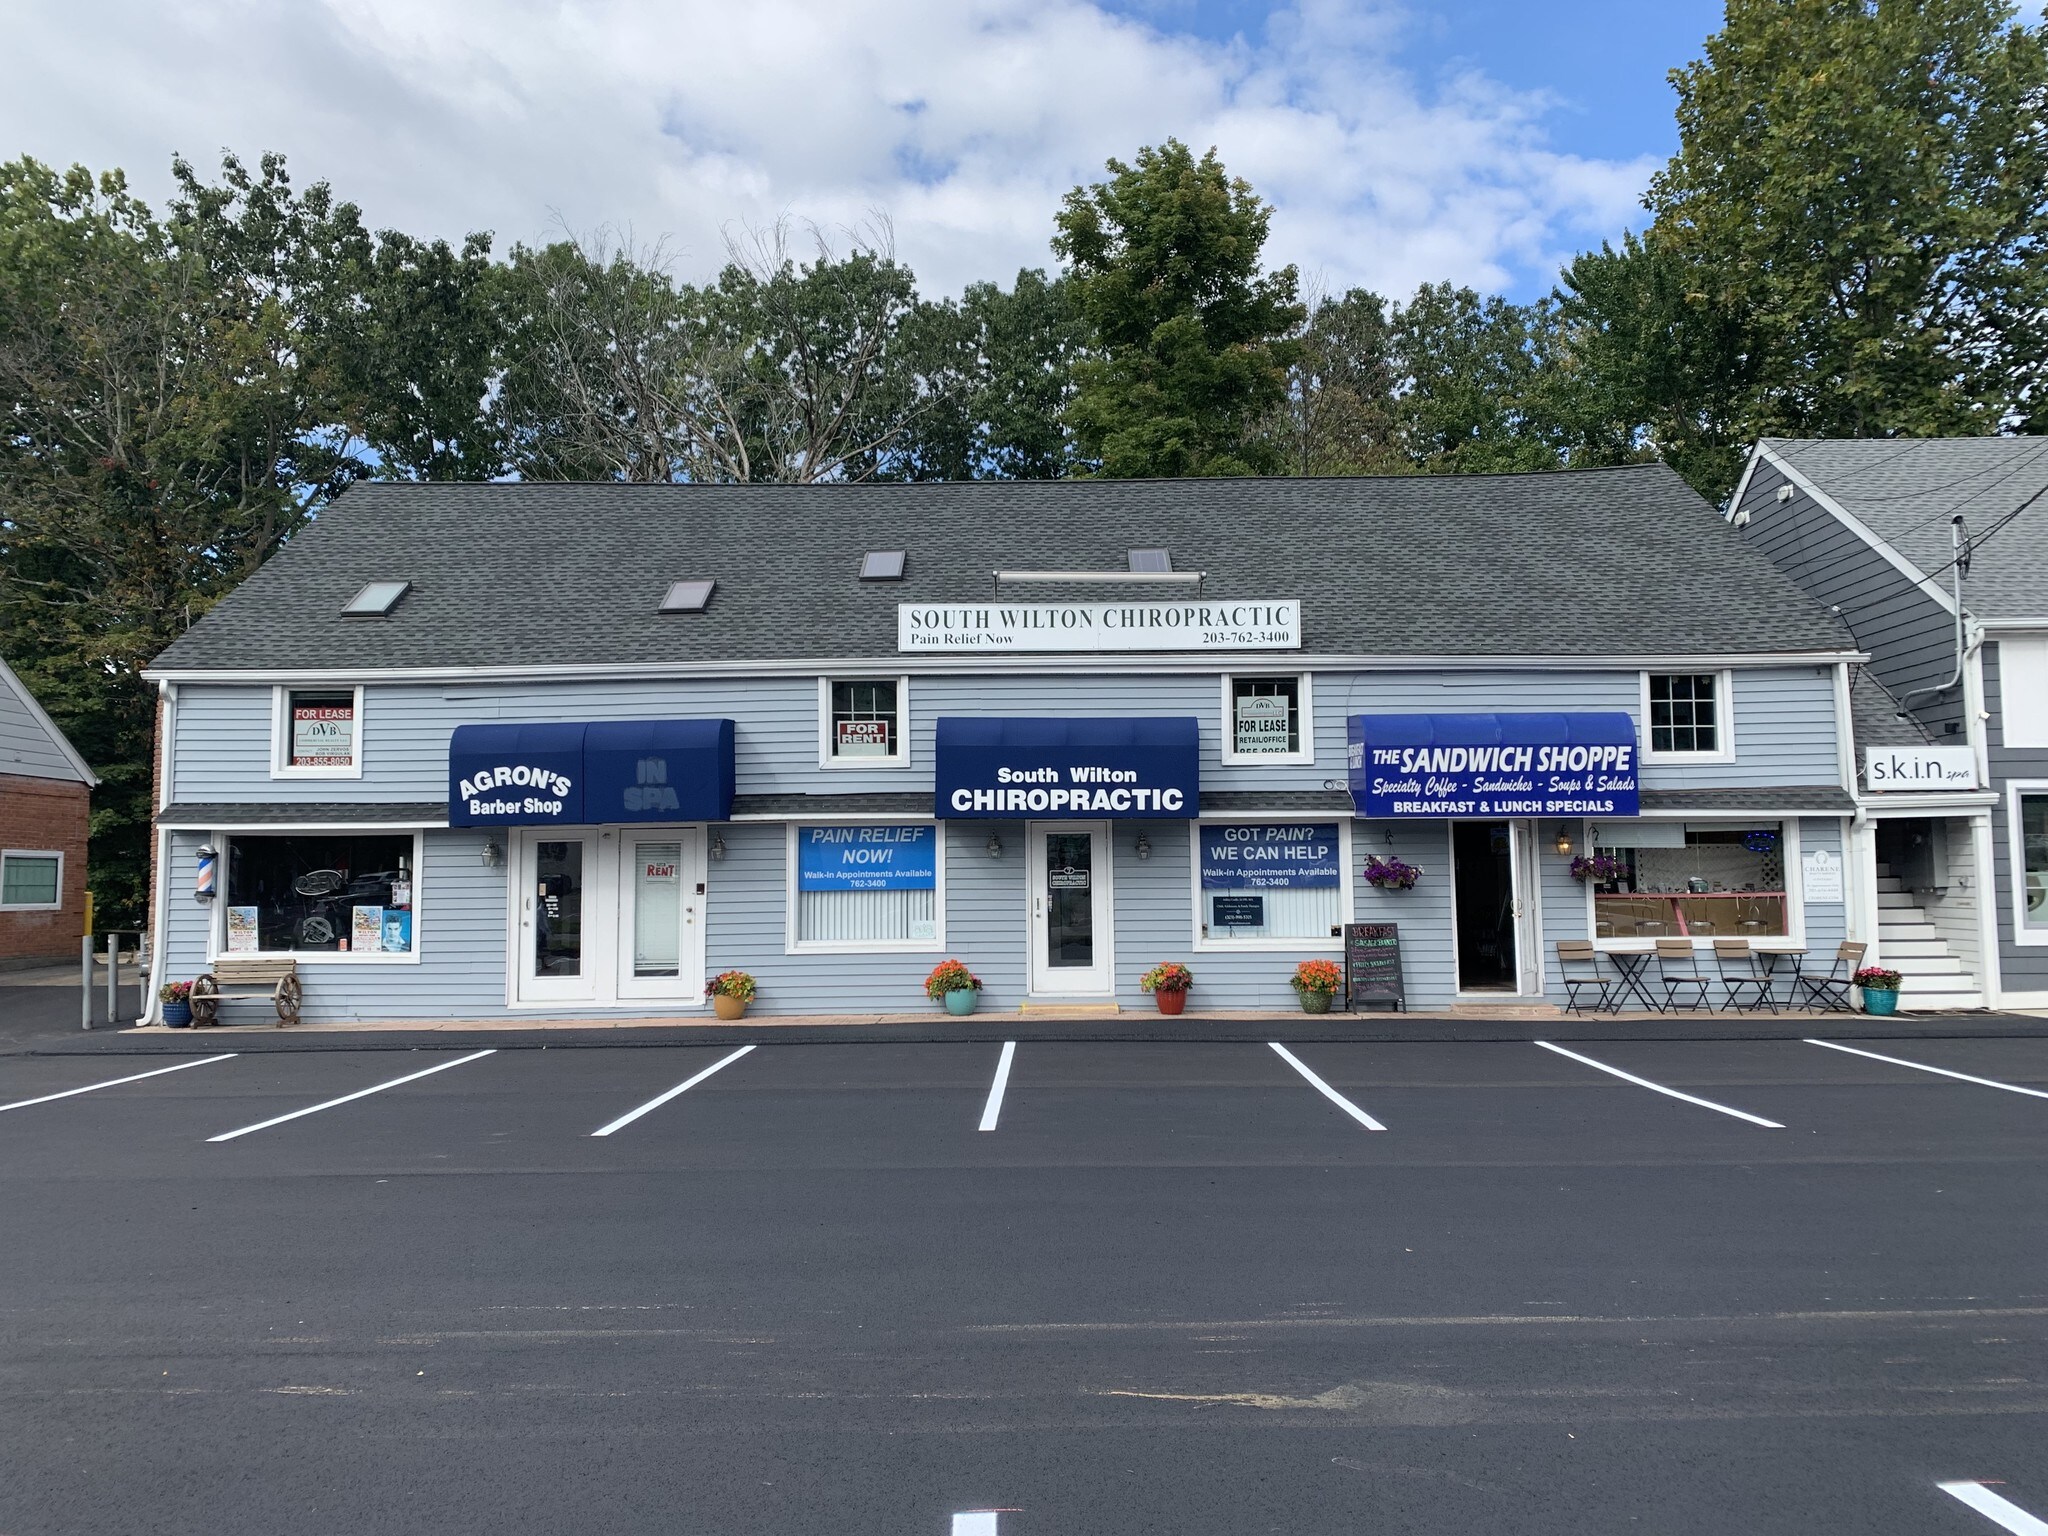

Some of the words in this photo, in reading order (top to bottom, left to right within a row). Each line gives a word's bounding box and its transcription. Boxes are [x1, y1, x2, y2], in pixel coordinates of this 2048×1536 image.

[911, 609, 990, 629] SOUTH
[1000, 609, 1093, 629] WILTON
[1103, 606, 1290, 628] CHIROPRACTIC
[911, 633, 939, 644] Pain
[944, 633, 982, 644] Relief
[985, 633, 1014, 644] Now
[1202, 631, 1290, 644] 203-762-3400
[296, 709, 317, 719] FOR
[319, 709, 351, 719] LEASE
[312, 723, 337, 736] DVB
[846, 724, 879, 734] FOR
[1238, 720, 1256, 733] FOR
[1258, 719, 1287, 732] LEASE
[841, 734, 884, 744] RENT
[1239, 736, 1287, 744] RETAIL/OFFICE
[1373, 749, 1401, 765] THE
[1400, 747, 1533, 773] SANDWICH
[1537, 746, 1632, 772] SHOPPE
[997, 767, 1059, 783] South
[1070, 767, 1137, 783] Wilton
[1874, 755, 1942, 780] s.k.i.n
[1946, 770, 1970, 782] spa
[459, 765, 572, 801] AGRON'S
[1371, 777, 1422, 798] Specialty
[1424, 775, 1458, 798] Coffee
[1472, 775, 1533, 794] Sandwiches
[1548, 775, 1581, 796] Soups
[1584, 774, 1594, 791] &
[1596, 775, 1636, 793] Salads
[623, 786, 680, 812] SPA
[951, 788, 1184, 812] CHIROPRACTIC
[469, 799, 521, 815] Barber
[523, 798, 563, 816] Shop
[1393, 801, 1475, 813] BREAKFAST
[1479, 801, 1490, 813] &
[1494, 801, 1542, 812] LUNCH
[1546, 800, 1615, 812] SPECIALS
[811, 828, 854, 843] PAIN
[858, 827, 925, 842] RELIEF
[1224, 828, 1260, 842] GOT
[1265, 827, 1314, 841] PAIN?
[842, 849, 893, 864] NOW!
[1210, 847, 1238, 860] WE
[1243, 846, 1279, 860] CAN
[1284, 846, 1329, 860] HELP
[647, 865, 675, 877] RENT
[836, 871, 893, 880] Appointments
[894, 869, 932, 878] Available
[1236, 868, 1296, 878] Appointments
[1298, 867, 1338, 877] Available
[850, 880, 887, 888] 762-3400
[1251, 878, 1290, 886] 762-3400
